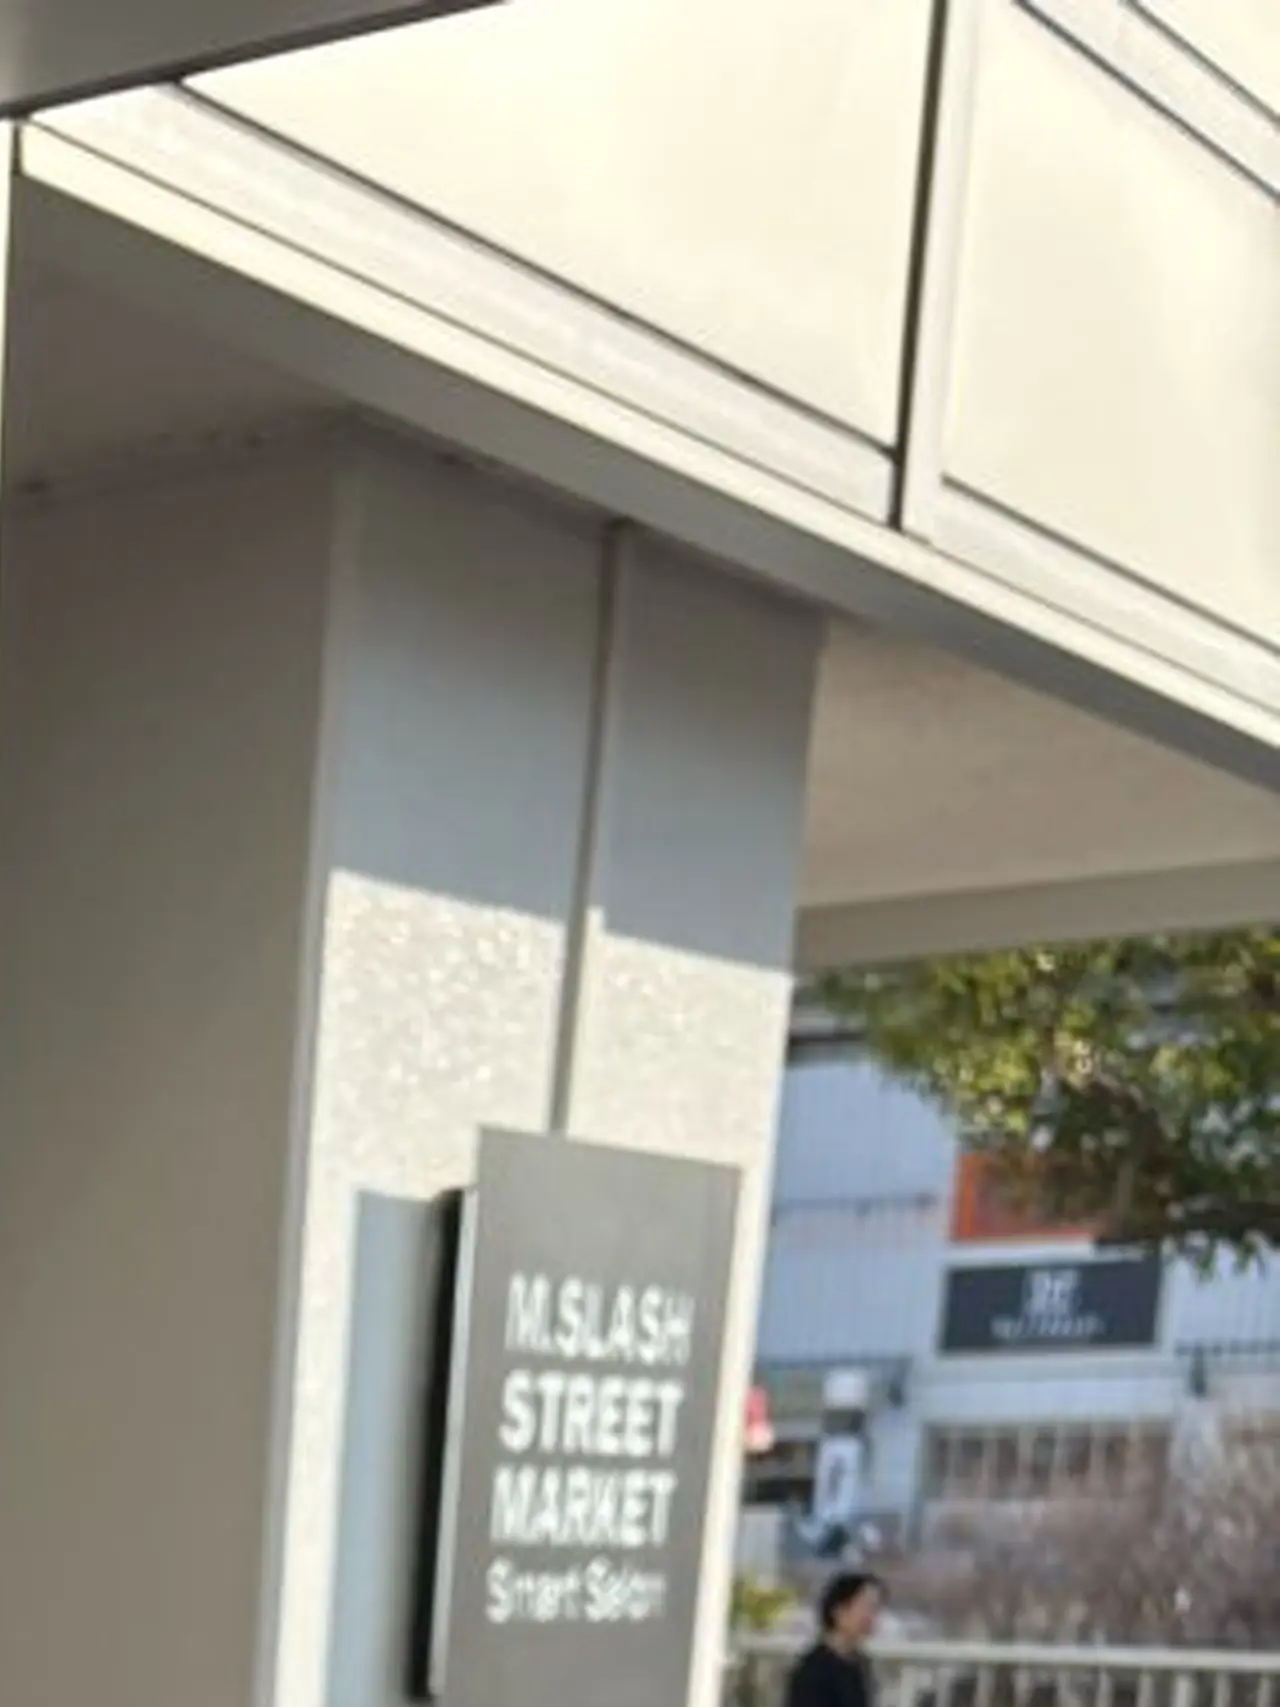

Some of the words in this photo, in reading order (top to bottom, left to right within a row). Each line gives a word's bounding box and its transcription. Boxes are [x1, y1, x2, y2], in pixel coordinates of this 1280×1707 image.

[505, 1271, 692, 1365] M.SLASH
[497, 1372, 684, 1457] STREET
[489, 1464, 677, 1548] MARKET
[486, 1558, 581, 1624] Smart
